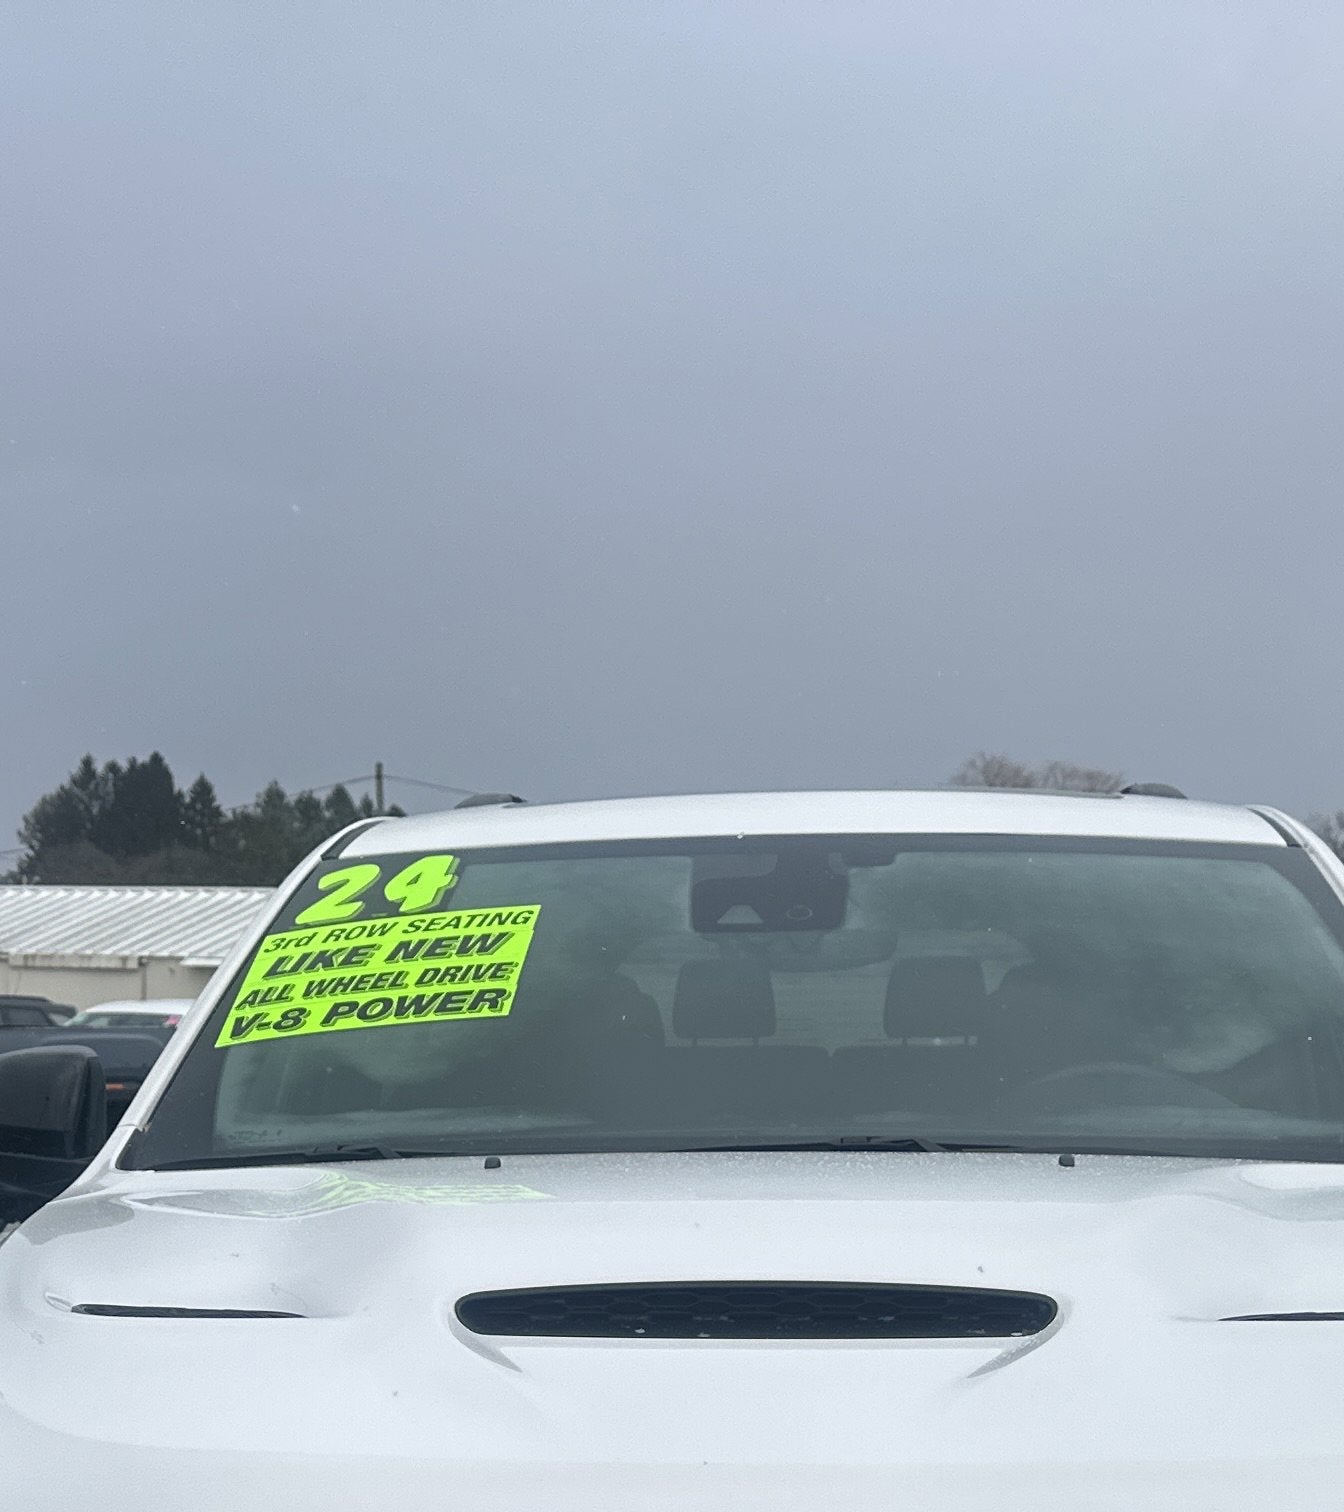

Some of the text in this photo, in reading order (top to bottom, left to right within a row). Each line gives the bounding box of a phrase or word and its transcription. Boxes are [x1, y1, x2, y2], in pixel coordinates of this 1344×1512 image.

[295, 854, 459, 925] 24
[261, 932, 514, 981] LIKE NEW
[263, 910, 536, 954] 3rd ROW SEATING
[235, 962, 518, 1011] ALL WHEEL DRIVE
[230, 987, 511, 1040] V-8 POWER
